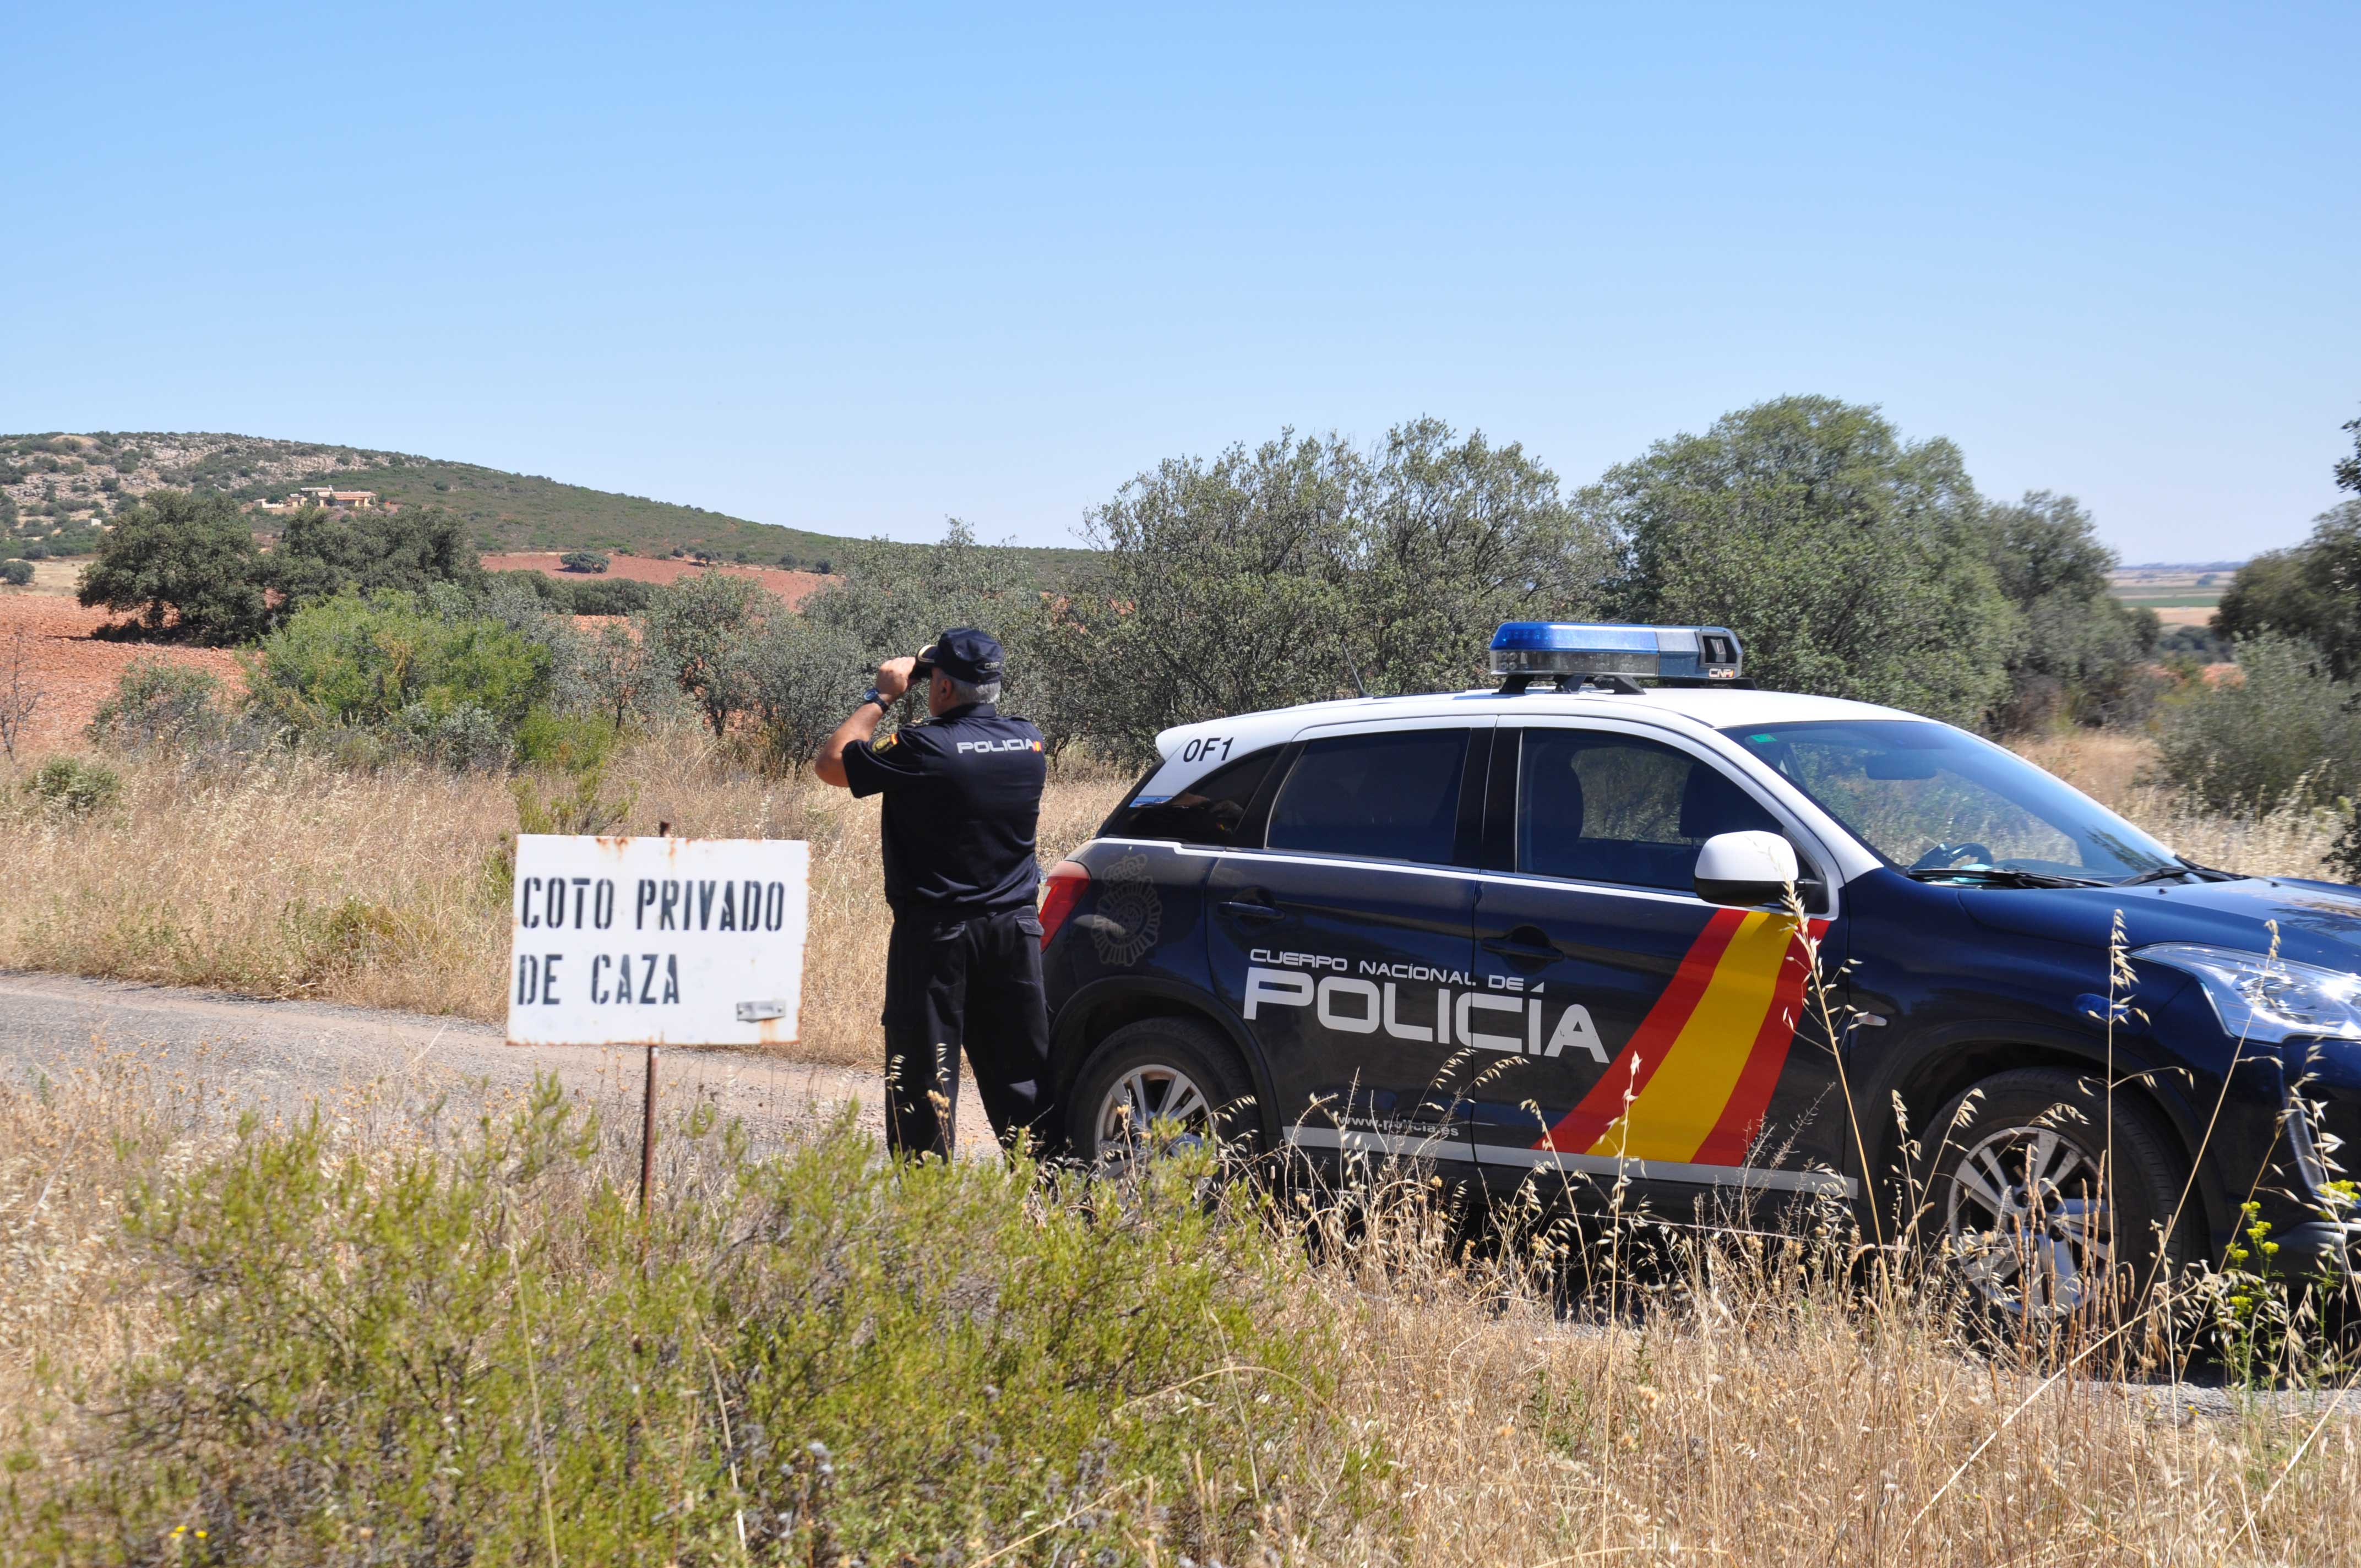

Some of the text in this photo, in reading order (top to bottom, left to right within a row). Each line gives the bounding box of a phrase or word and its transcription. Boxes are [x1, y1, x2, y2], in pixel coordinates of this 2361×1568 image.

[956, 738, 1035, 754] POLICIA
[522, 876, 785, 932] COTO PRIVADO
[516, 954, 681, 1005] DE CAZA
[1250, 949, 1348, 971] CUERPO
[1488, 974, 1524, 991] DE
[1243, 966, 1611, 1064] POLICÍA
[1338, 1116, 1459, 1136] www.poiciaes
